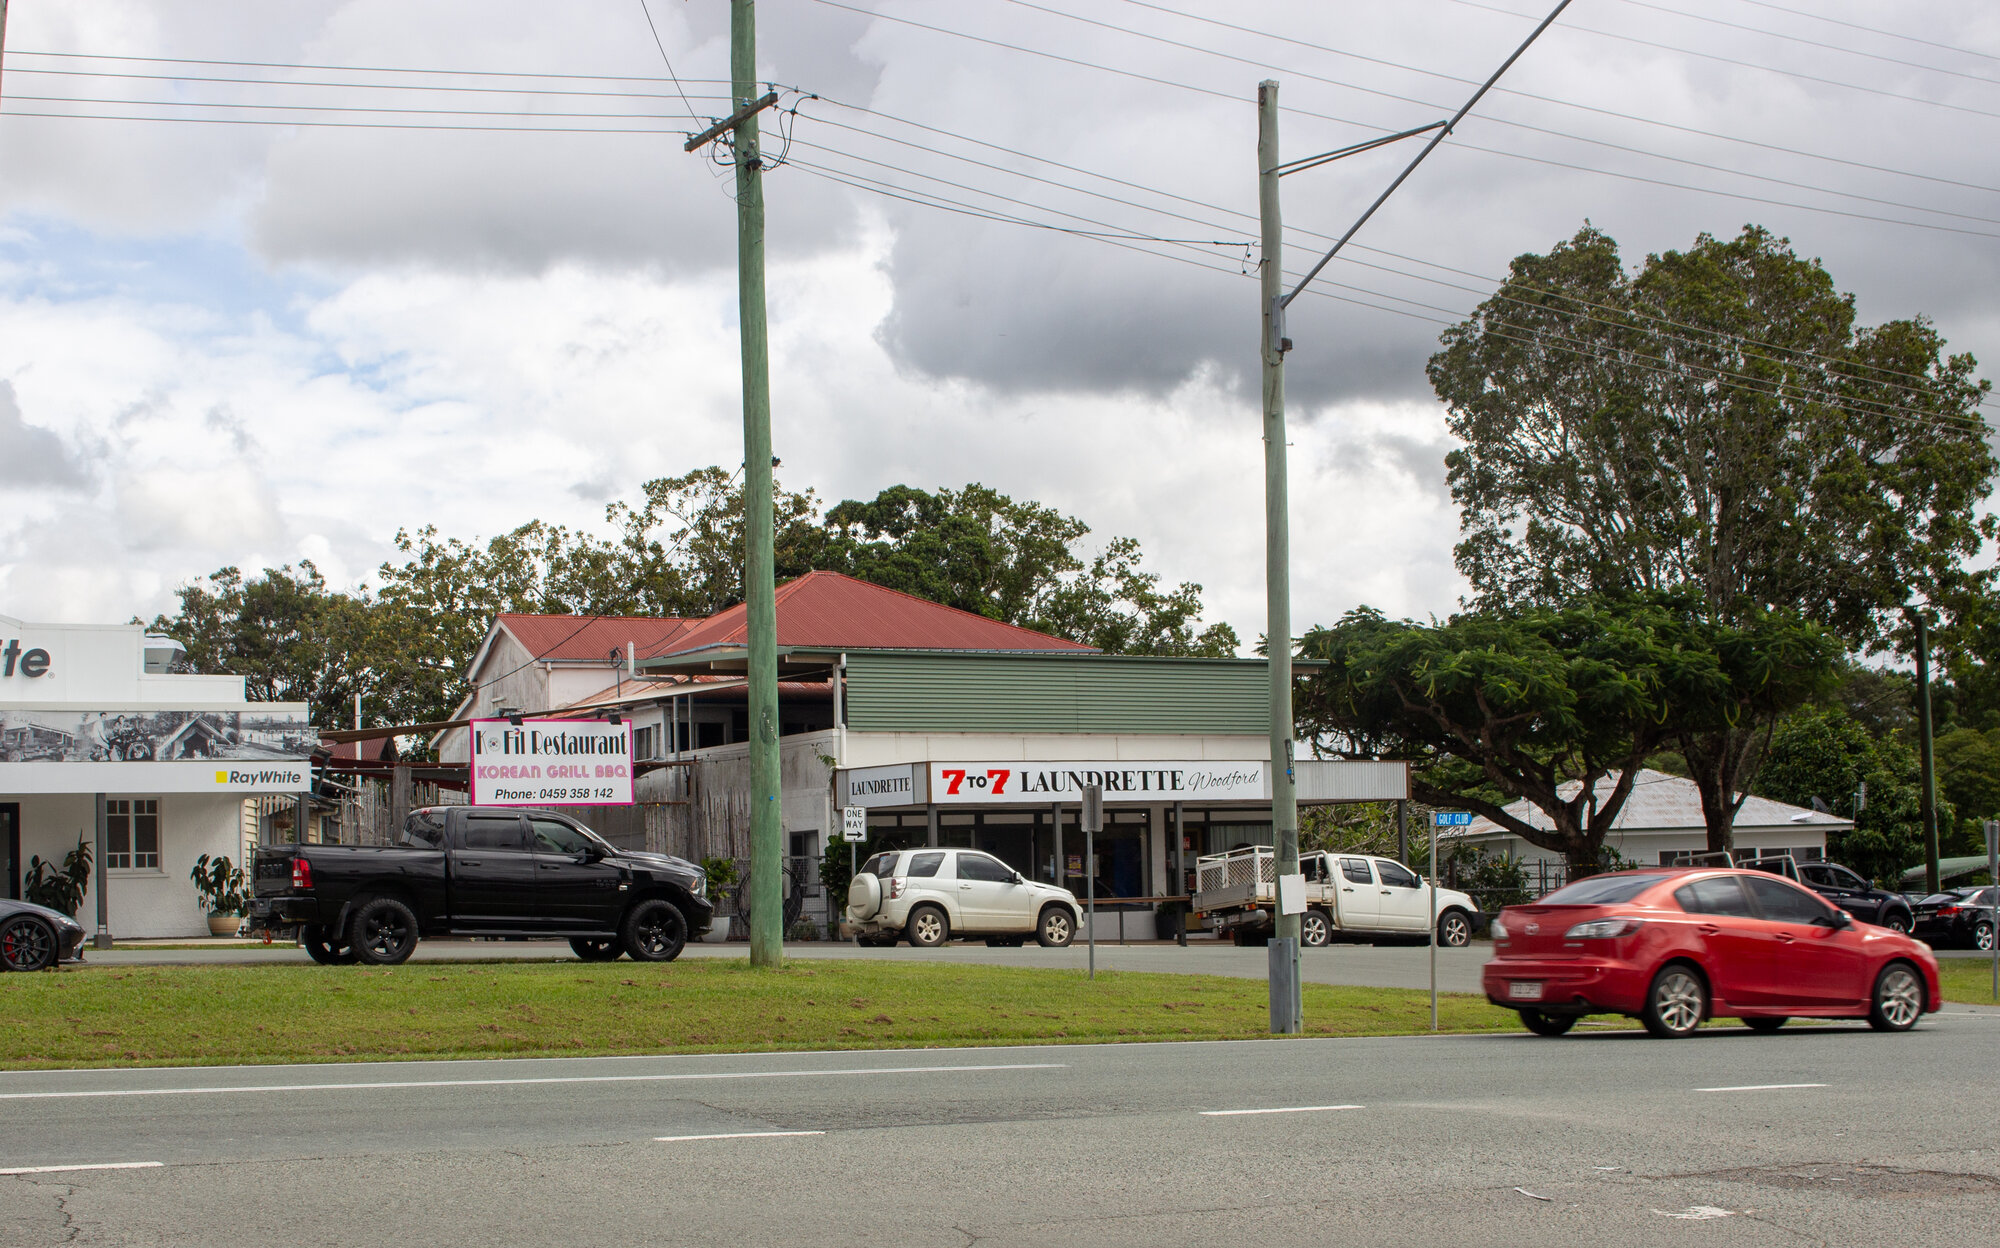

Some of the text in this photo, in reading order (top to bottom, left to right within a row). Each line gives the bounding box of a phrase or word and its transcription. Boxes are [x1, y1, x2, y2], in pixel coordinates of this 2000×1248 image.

[0, 639, 50, 677] te
[532, 731, 628, 755] Restaurant
[478, 765, 628, 778] KOREAN GRILL BBQ
[852, 777, 911, 796] LAUNDRETTE
[1020, 770, 1185, 792] LAUNDRETTE
[1188, 770, 1259, 792] Woodford
[495, 788, 613, 799] Phone: 0459 358 142
[846, 809, 863, 818] ONE
[1439, 814, 1469, 824] GOLF CLUB
[846, 820, 864, 829] WAY
